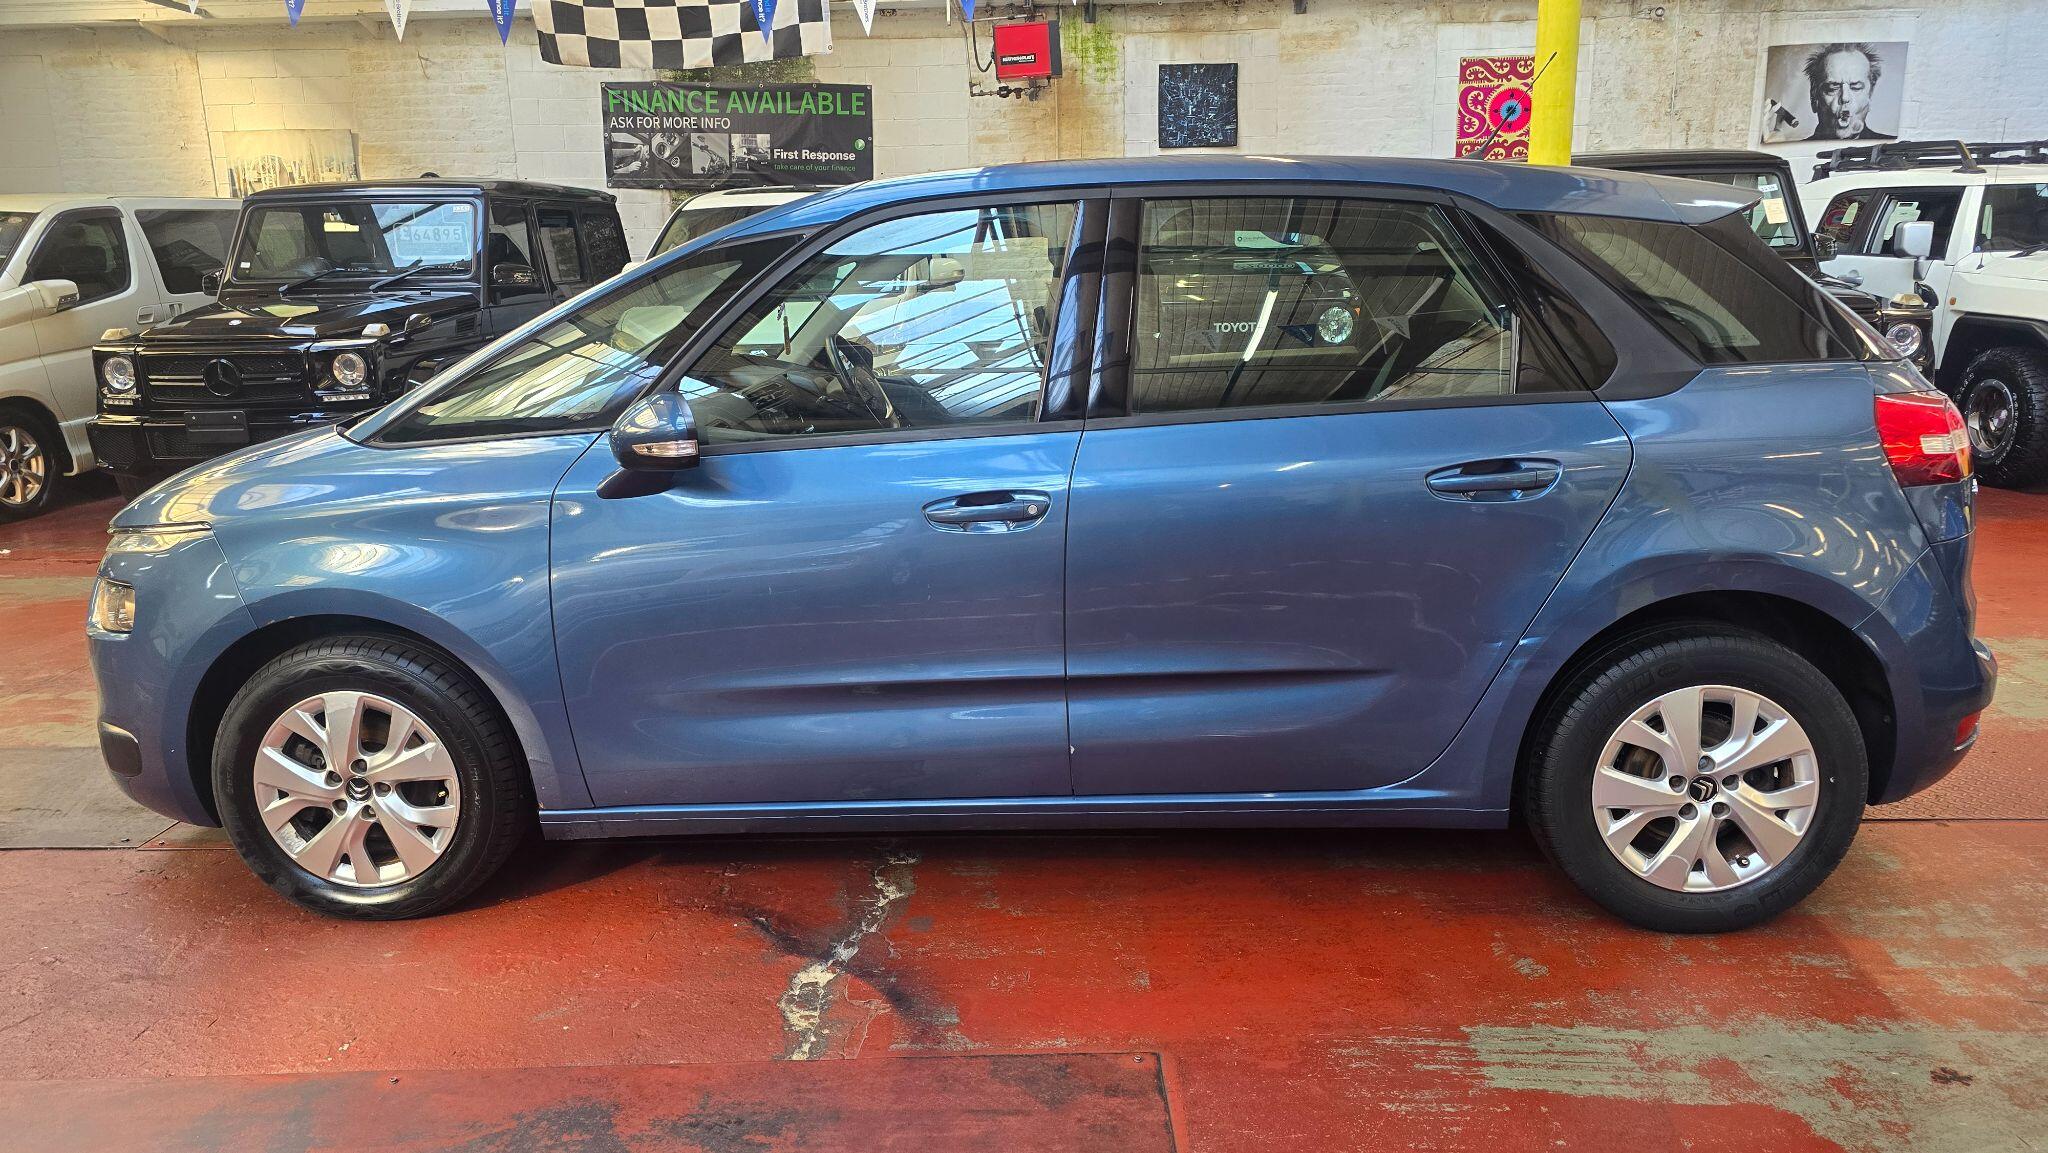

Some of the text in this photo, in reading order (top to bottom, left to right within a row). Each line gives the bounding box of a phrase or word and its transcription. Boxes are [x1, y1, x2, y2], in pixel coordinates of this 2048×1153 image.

[608, 89, 866, 116] FINANCE AVAILABLE
[610, 116, 731, 129] ASK FOR MORE INFO
[773, 148, 856, 163] First Response
[805, 163, 813, 171] of
[831, 164, 856, 172] finance
[1213, 322, 1258, 333] TOYOT
